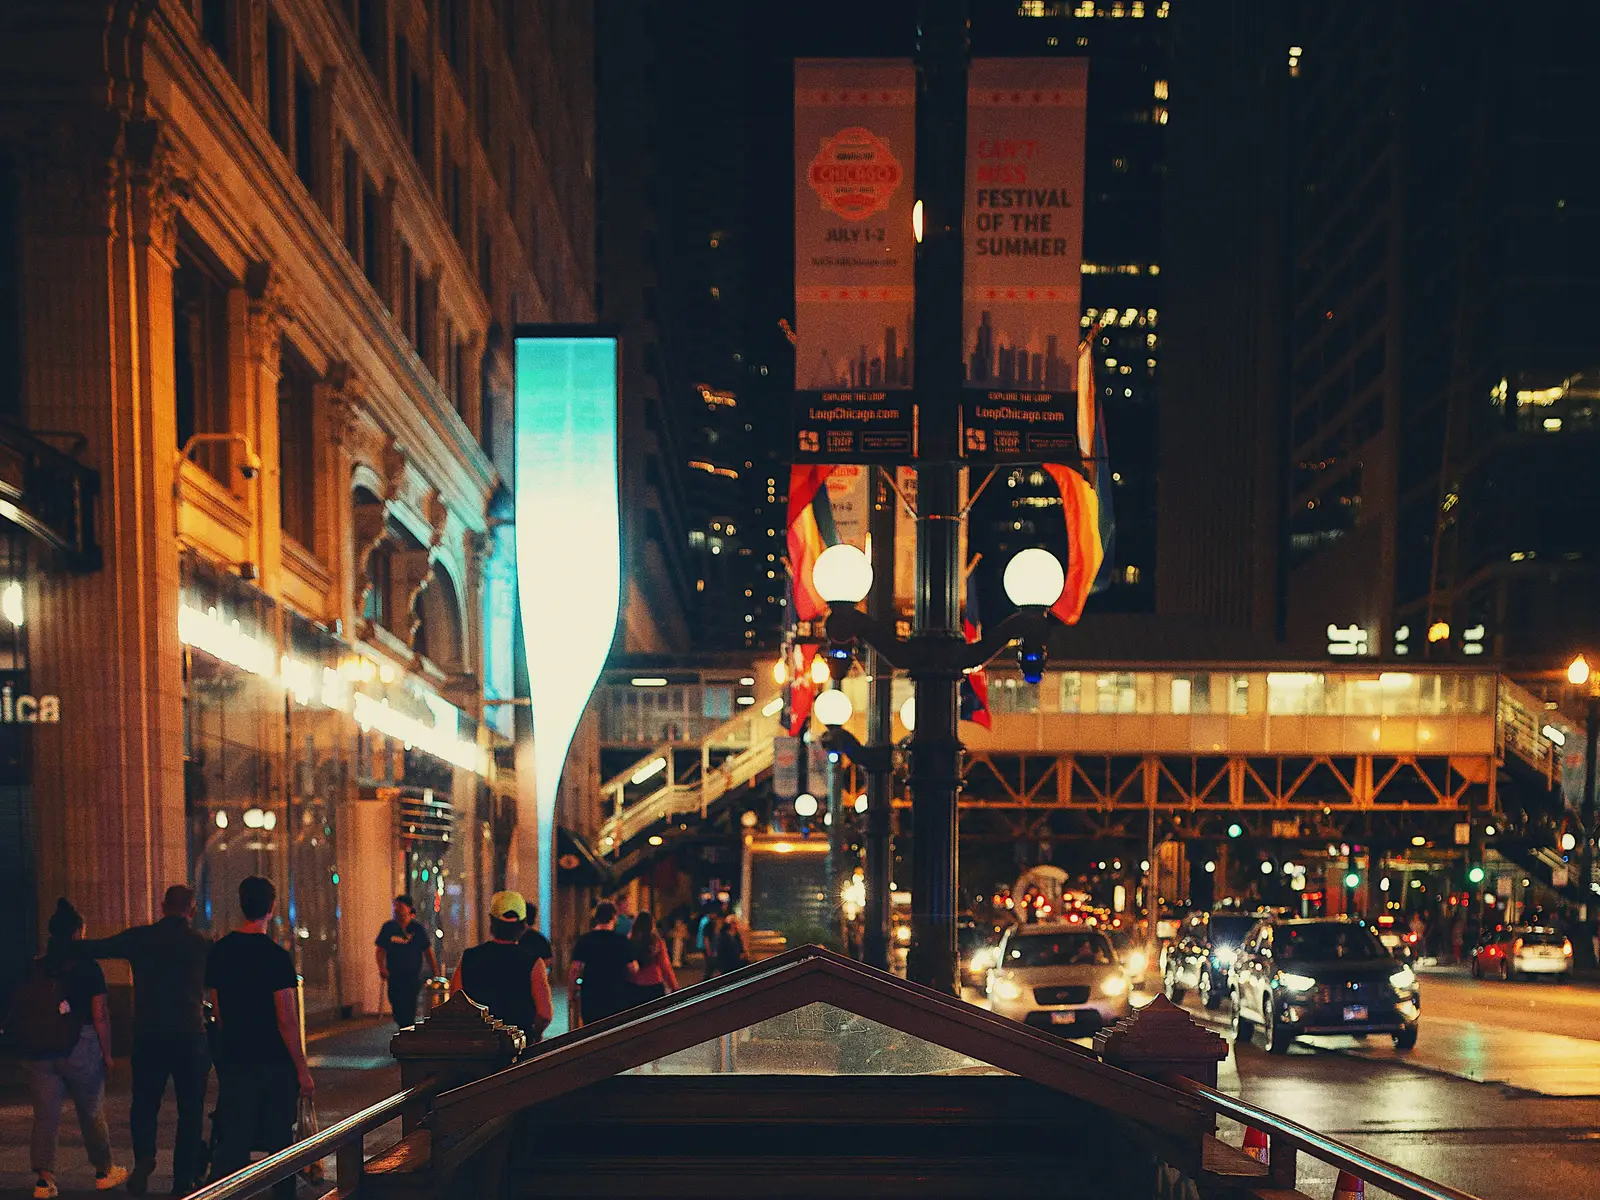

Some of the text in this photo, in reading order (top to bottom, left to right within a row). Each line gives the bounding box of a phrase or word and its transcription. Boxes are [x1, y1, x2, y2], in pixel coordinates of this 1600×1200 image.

[977, 164, 1027, 183] MISS
[977, 188, 1072, 208] FESTIVAL
[976, 213, 1052, 232] OF THE
[827, 228, 885, 242] JULY 1-2
[976, 238, 1067, 256] SUMMER
[809, 407, 900, 423] LoopChicago.com
[975, 404, 1065, 424] LoopChicago.com
[0, 686, 60, 723] ica
